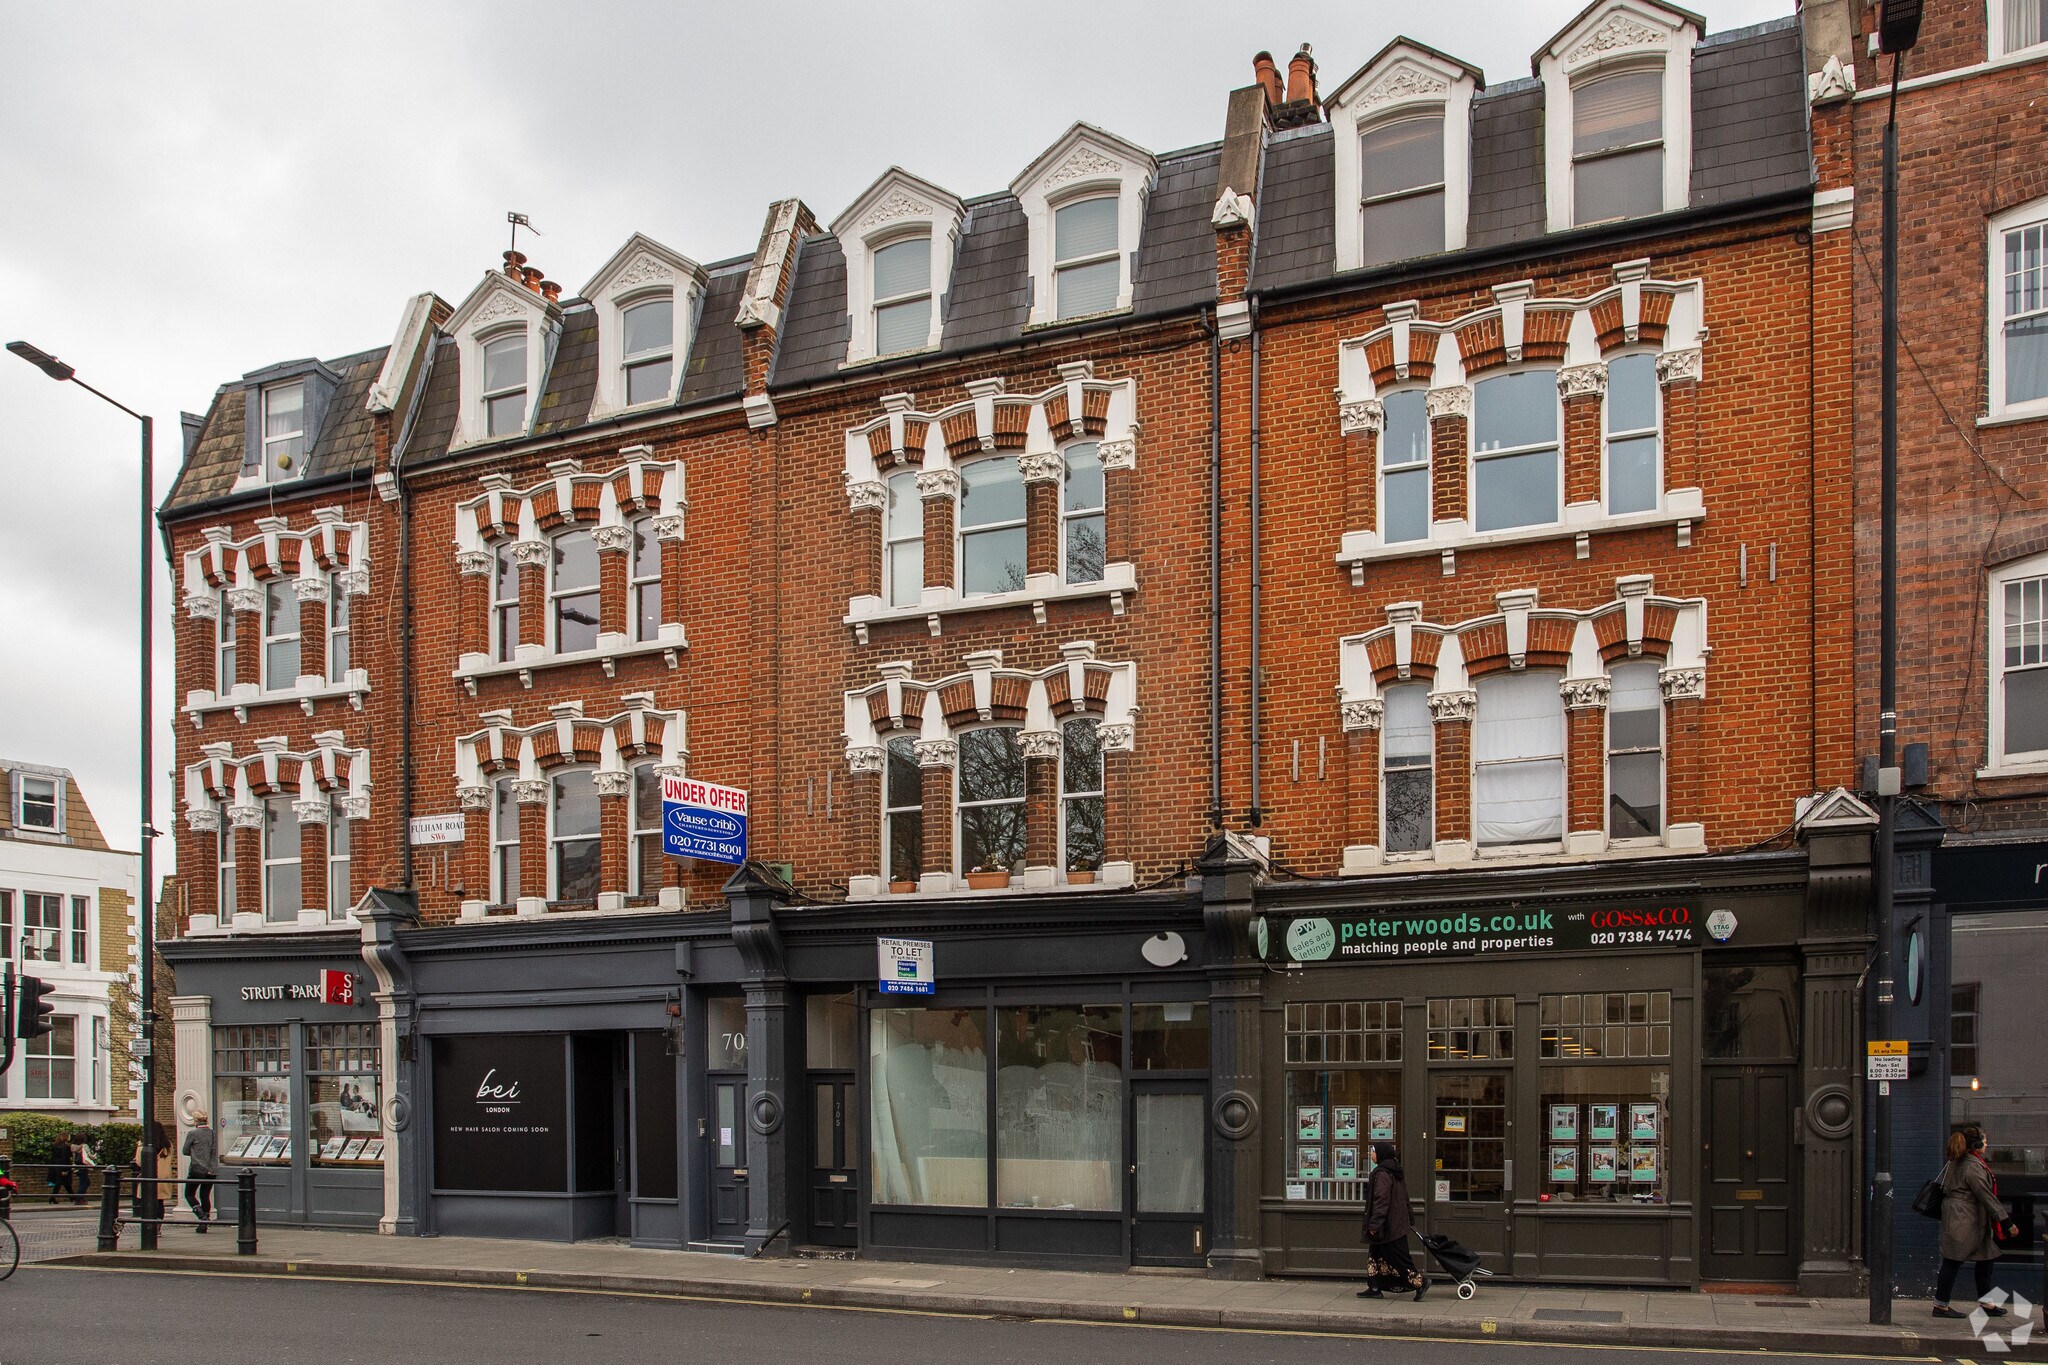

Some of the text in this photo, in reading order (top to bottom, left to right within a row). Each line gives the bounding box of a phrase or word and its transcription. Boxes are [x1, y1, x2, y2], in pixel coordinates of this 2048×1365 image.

[665, 779, 745, 812] UNDER OFFER
[411, 821, 465, 833] FULHAM ROAD
[676, 811, 736, 831] Vause Cribb
[431, 833, 446, 841] SW6
[669, 834, 741, 856] 020 7731 8001
[1341, 909, 1553, 942] peterwoods.co.uk
[1567, 907, 1692, 928] with GOSS&CO.
[902, 940, 931, 949] PREMISES
[1292, 928, 1331, 953] sales and
[1342, 935, 1554, 955] matching people and properties
[1590, 928, 1692, 945] 020 7384 7474
[891, 947, 922, 957] TO LET
[1300, 940, 1331, 960] lettings
[343, 974, 352, 988] S
[241, 985, 284, 1000] STRUTT
[291, 984, 321, 999] PARK
[721, 1032, 748, 1050] 70
[476, 1068, 521, 1098] bei
